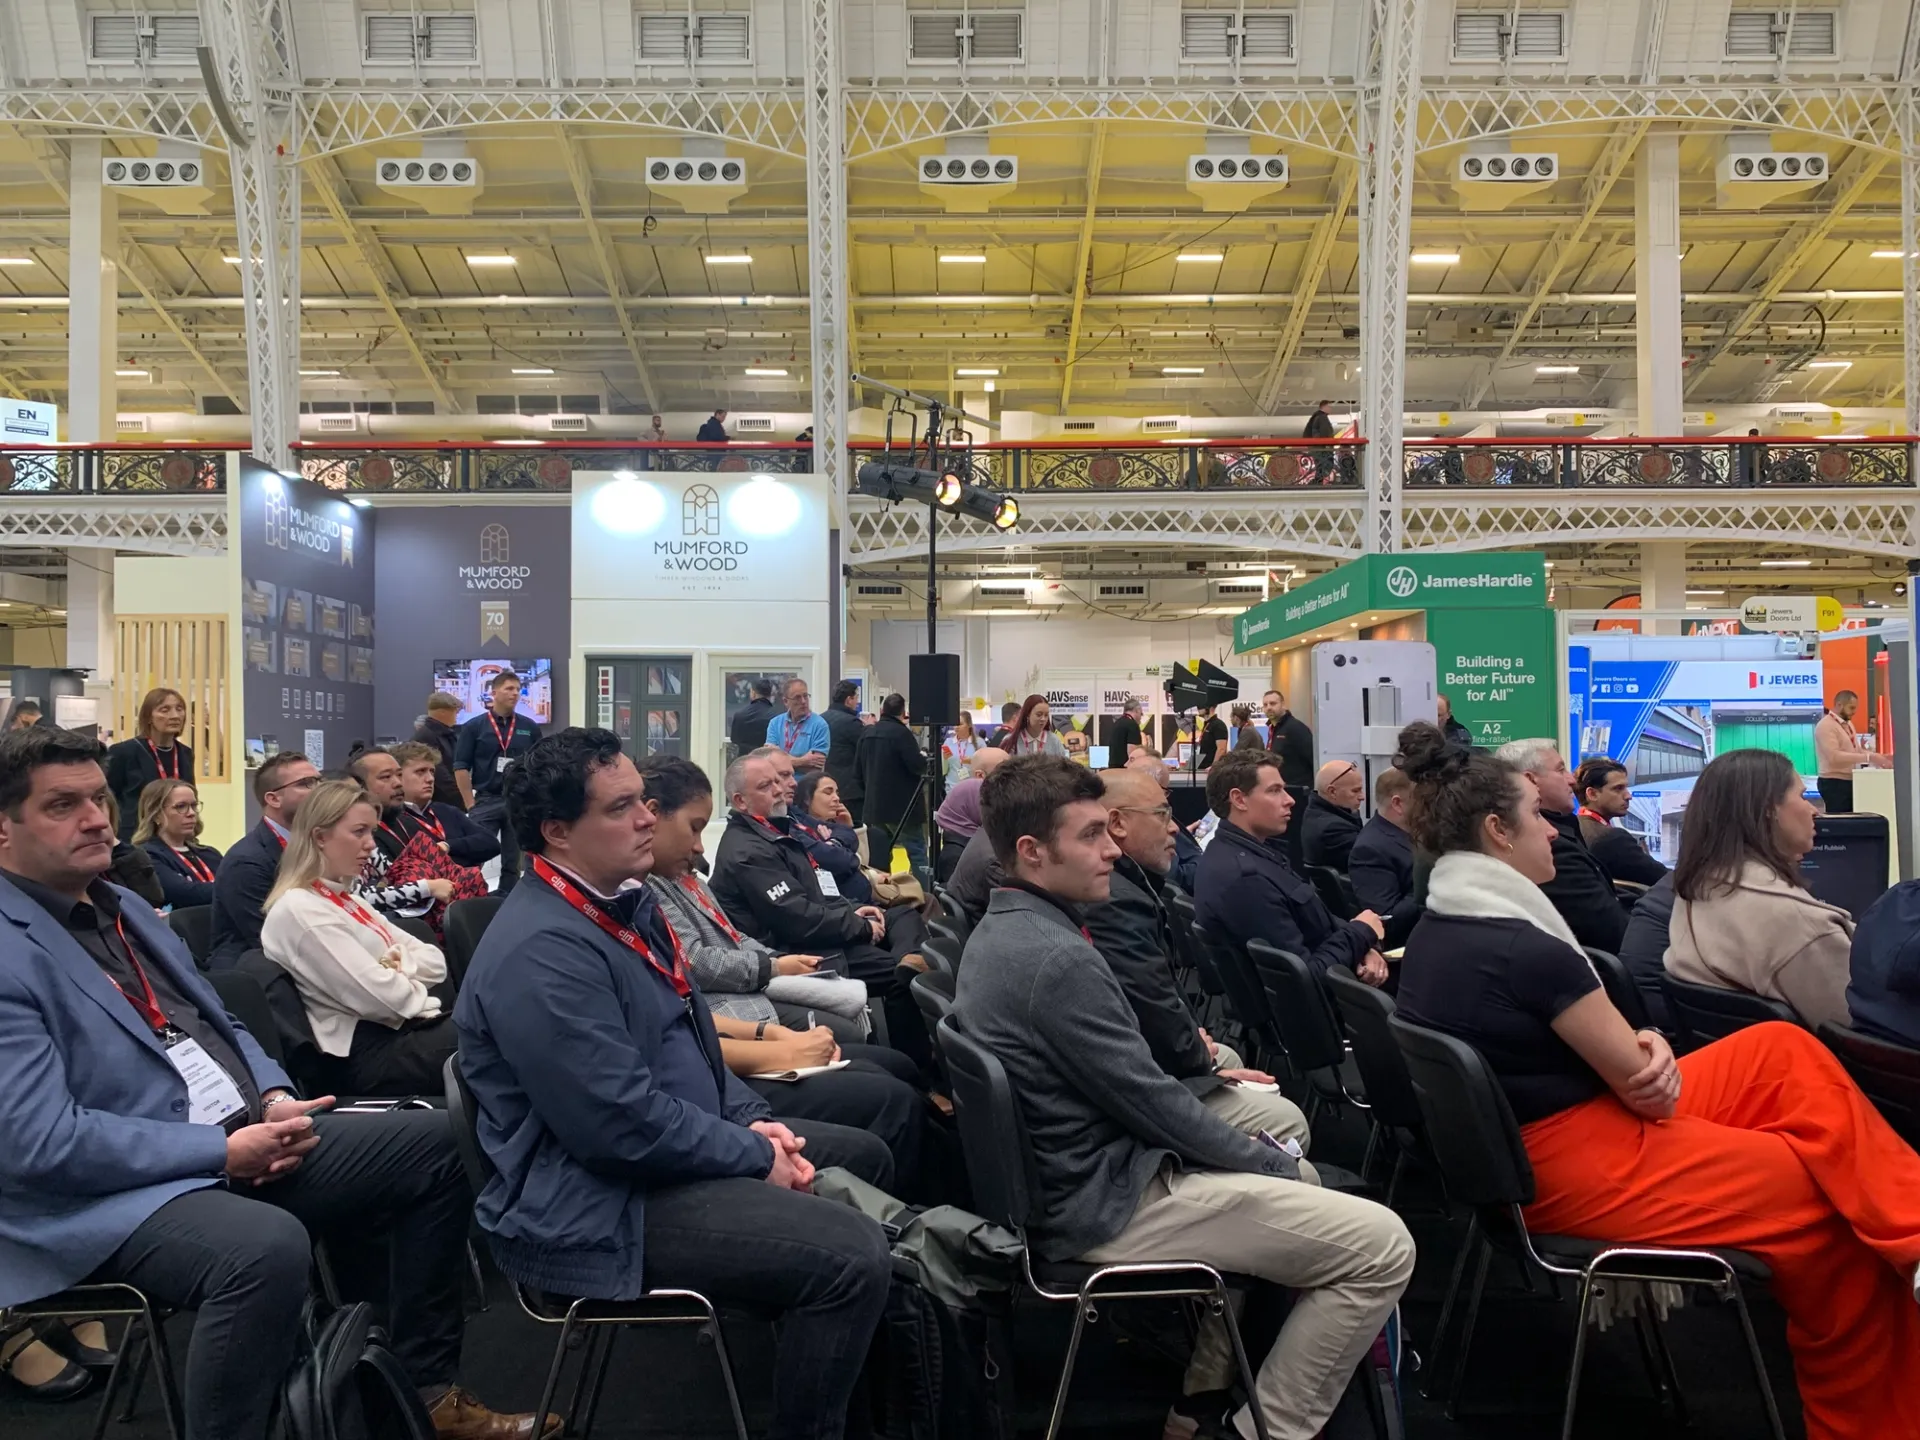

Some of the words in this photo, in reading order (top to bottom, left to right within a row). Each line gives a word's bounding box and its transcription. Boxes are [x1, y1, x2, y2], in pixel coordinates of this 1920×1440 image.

[18, 409, 37, 420] EN
[290, 506, 340, 538] MUMFORD
[654, 541, 748, 555] MUMFORD
[459, 566, 531, 577] MUMFORD
[1422, 573, 1533, 588] JamesHardie
[1285, 606, 1301, 621] Building
[1304, 599, 1318, 614] Better
[1318, 595, 1332, 609] Future
[486, 612, 505, 626] 70
[1456, 655, 1511, 670] Building
[1515, 657, 1524, 667] a
[1445, 672, 1488, 684] Better
[1491, 672, 1536, 684] Future
[1768, 674, 1818, 685] JEWERS
[1466, 689, 1486, 701] for
[766, 880, 791, 901] HH
